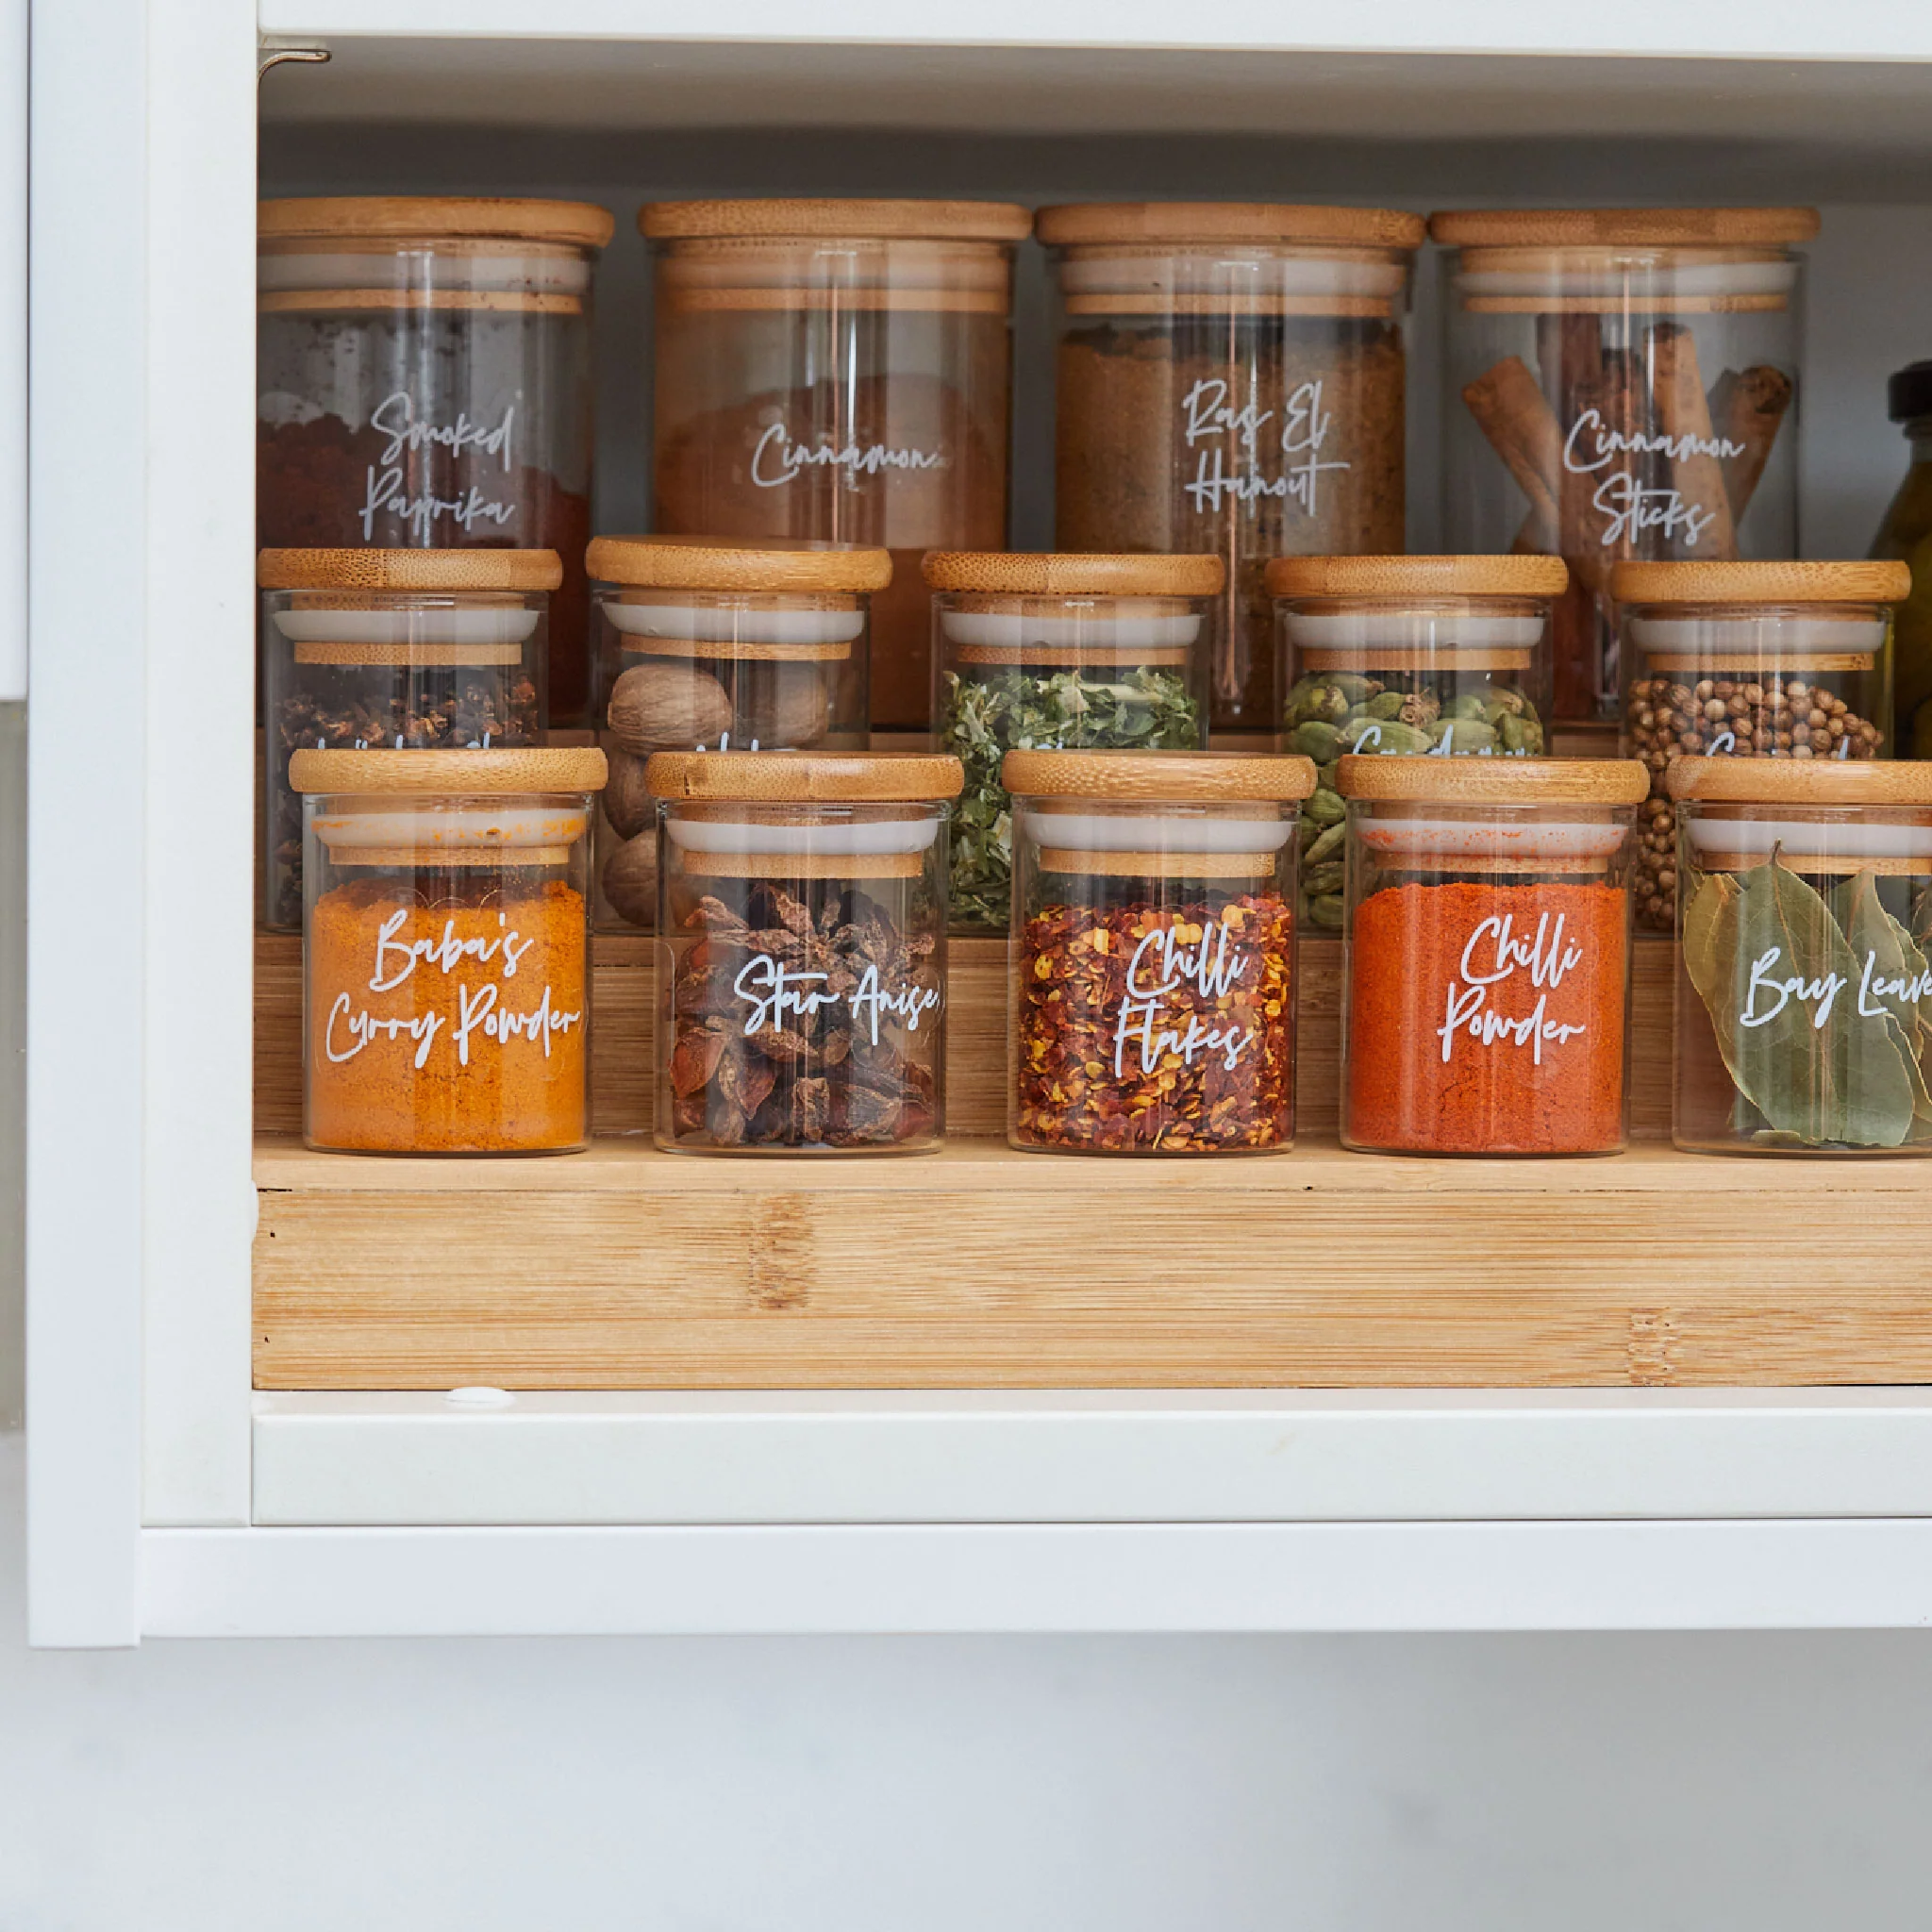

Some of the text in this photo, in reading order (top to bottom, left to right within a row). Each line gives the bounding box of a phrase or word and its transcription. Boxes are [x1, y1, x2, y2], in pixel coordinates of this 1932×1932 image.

[371, 391, 516, 471] Smoked
[751, 423, 938, 487] Cinnamon
[1282, 380, 1332, 452] El
[1563, 408, 1745, 473] Cinnamon
[358, 465, 517, 541] Paprika
[1184, 447, 1352, 518] Hanout
[1593, 472, 1716, 546] Sticks
[369, 908, 535, 991] Baba's
[1126, 921, 1249, 999] Chilli
[1461, 911, 1584, 989] Chilli
[1740, 946, 1848, 1028] Bay
[325, 983, 581, 1068] Curry Powder
[733, 955, 939, 1045] Star Anise
[1112, 995, 1254, 1078] Flakes
[1437, 982, 1587, 1065] Powder
